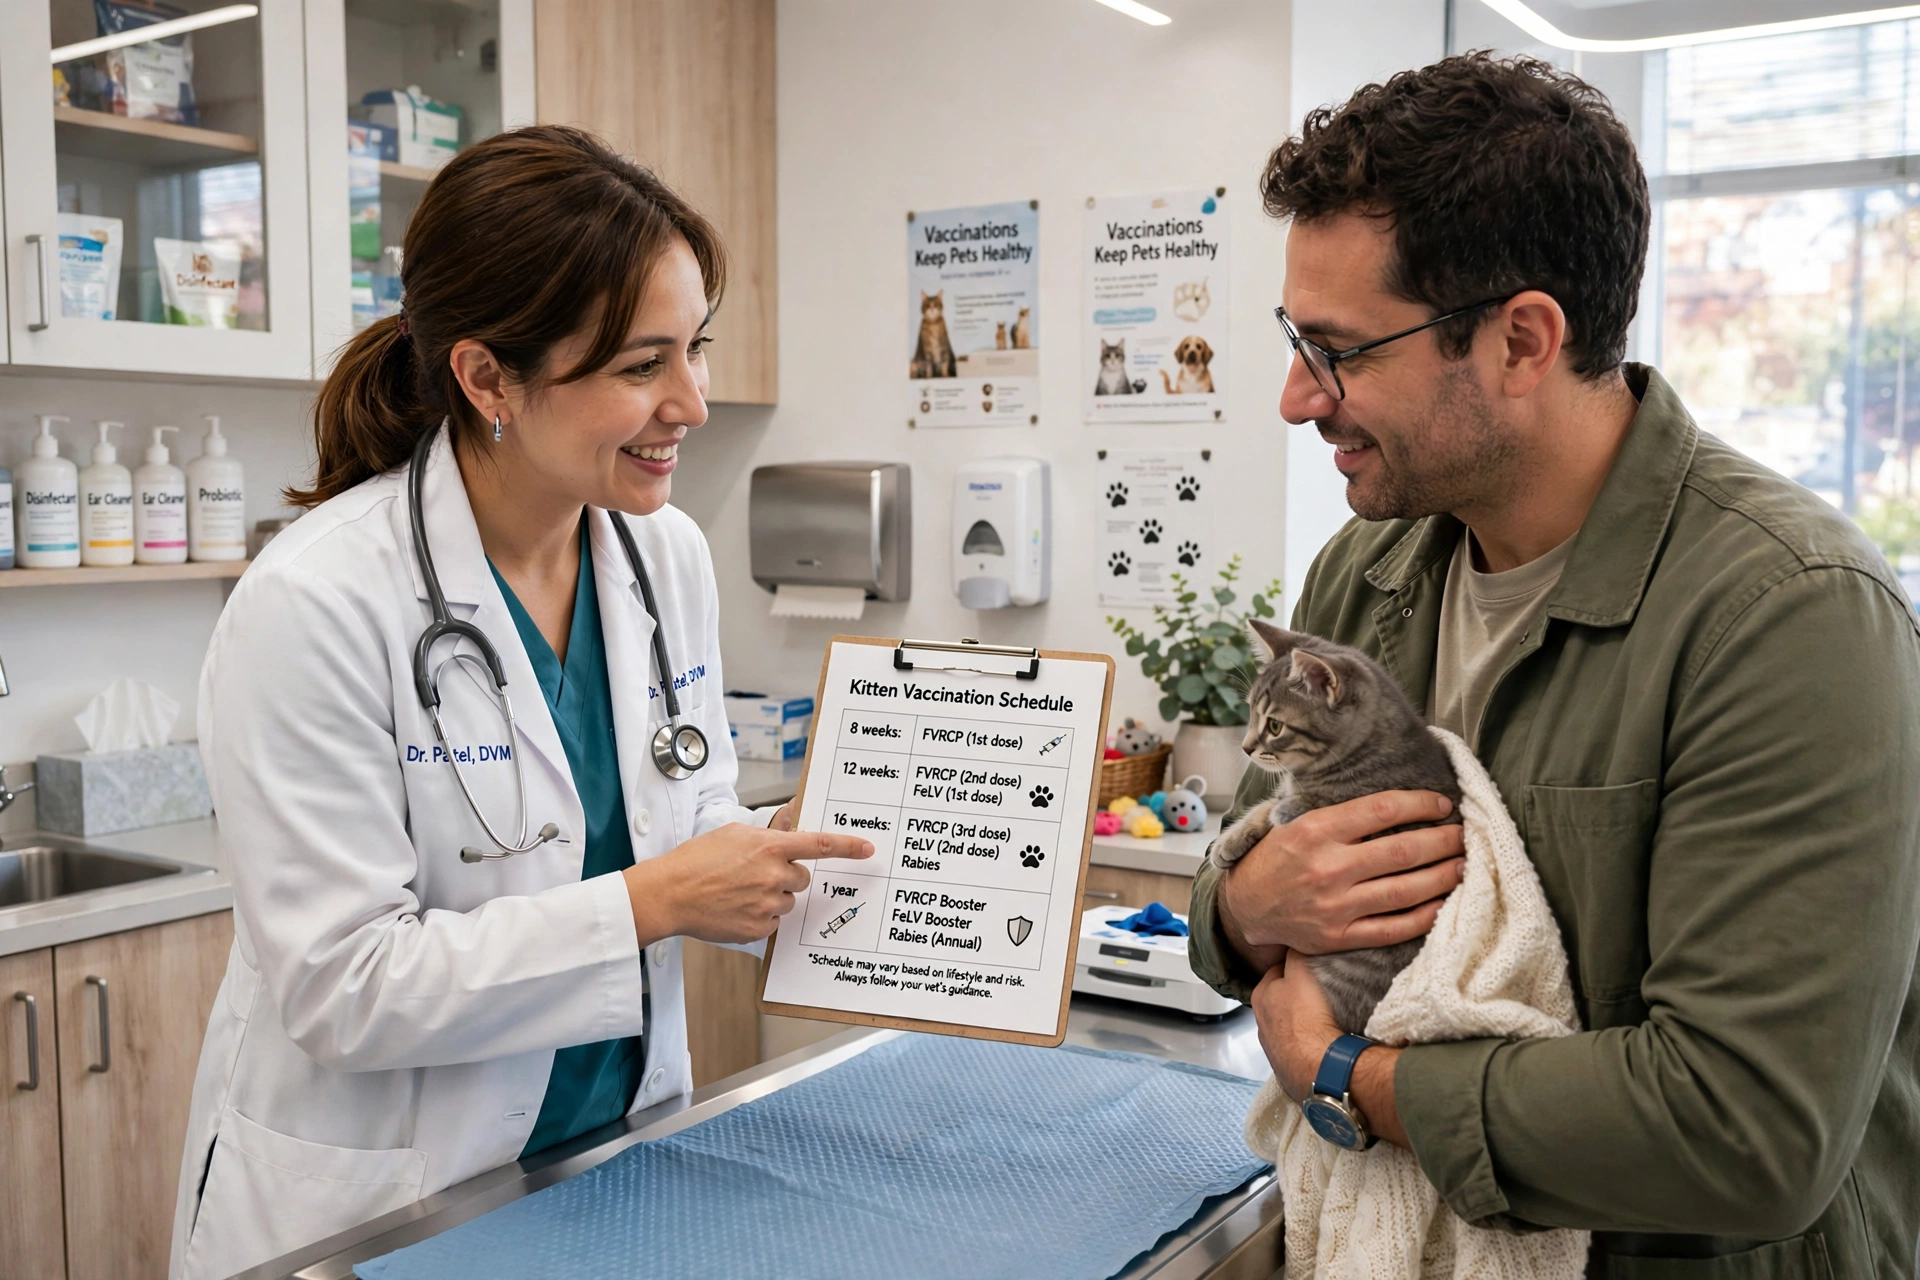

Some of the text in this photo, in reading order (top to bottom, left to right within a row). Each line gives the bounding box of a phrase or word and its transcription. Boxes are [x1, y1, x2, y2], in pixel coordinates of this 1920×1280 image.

[924, 221, 1019, 244] Vaccinations
[1107, 217, 1203, 240] Vaccinations
[915, 242, 1033, 269] Keep Pets Healthy
[1095, 238, 1218, 266] Keep Pets Healthy
[88, 493, 102, 505] Ear
[143, 492, 155, 505] Ear
[648, 665, 706, 699] Dr. Ptel, DVM
[850, 679, 1074, 712] Kitten Vaccination Schedule
[850, 722, 902, 738] 8 weeks:
[922, 728, 1023, 751] FVRCP (1st dose)
[406, 745, 512, 765] Dr. Patel, DVM
[843, 762, 900, 779] 12 weeks:
[915, 766, 1022, 790] FVRCP (2nd dose)
[913, 784, 1003, 806] FeLV (1st dose)
[834, 813, 891, 831] 16 weeks:
[907, 818, 1011, 843] FVRCP (3rd dose)
[904, 837, 1000, 861] FeLV (2nd dose)
[901, 855, 941, 871] Rabies
[822, 882, 859, 898] 1 year
[895, 890, 987, 912] FVRCP Booster
[892, 908, 972, 930] FeLV Booster
[889, 927, 982, 952] Rabies (Annual)
[834, 971, 993, 998] Always follow your vet's guidance.
[856, 960, 877, 973] may
[879, 963, 899, 976] vary
[902, 963, 930, 978] based
[932, 968, 944, 979] on
[946, 968, 983, 986] lifestyle
[985, 974, 1004, 985] and
[1005, 975, 1025, 987] risk.
